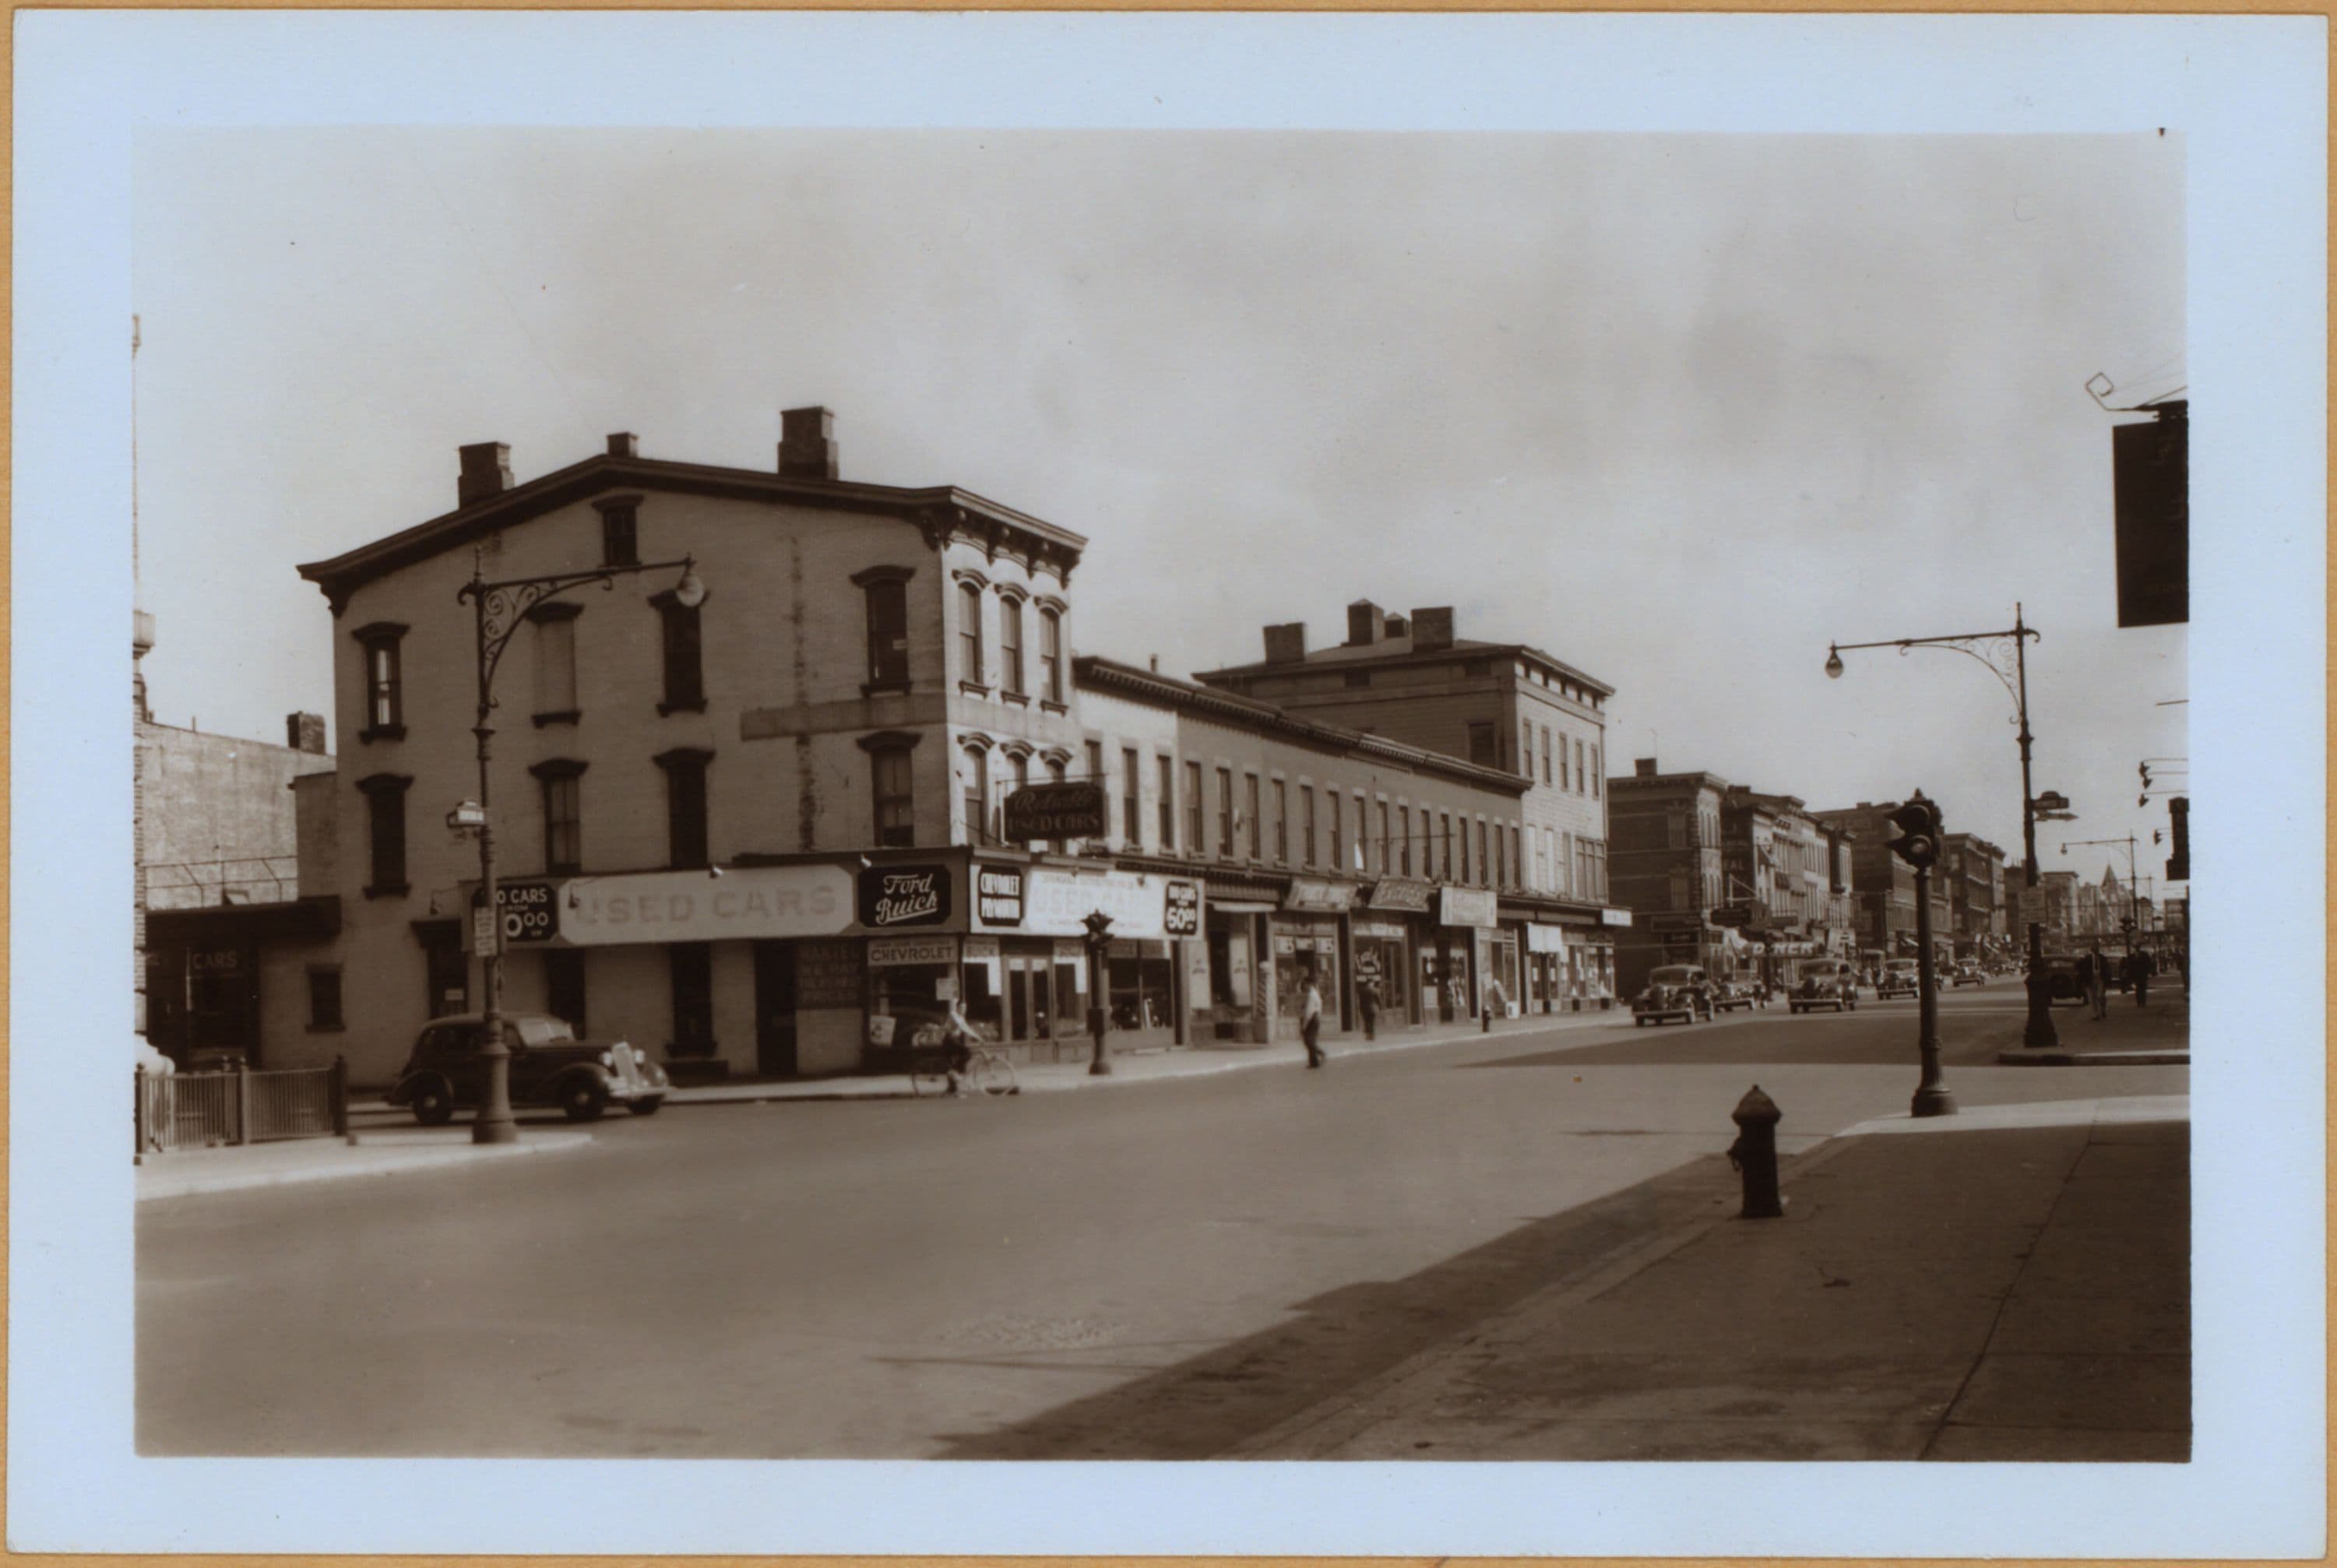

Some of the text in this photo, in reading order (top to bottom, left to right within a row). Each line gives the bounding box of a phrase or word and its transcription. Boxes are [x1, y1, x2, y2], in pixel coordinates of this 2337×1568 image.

[883, 873, 934, 895] Ford
[510, 888, 547, 903] CARS
[575, 884, 836, 925] USED CARS
[875, 891, 938, 925] Buick
[871, 946, 952, 962] CHEVROLET
[1752, 942, 1814, 955] DNER
[192, 949, 237, 969] CARS
